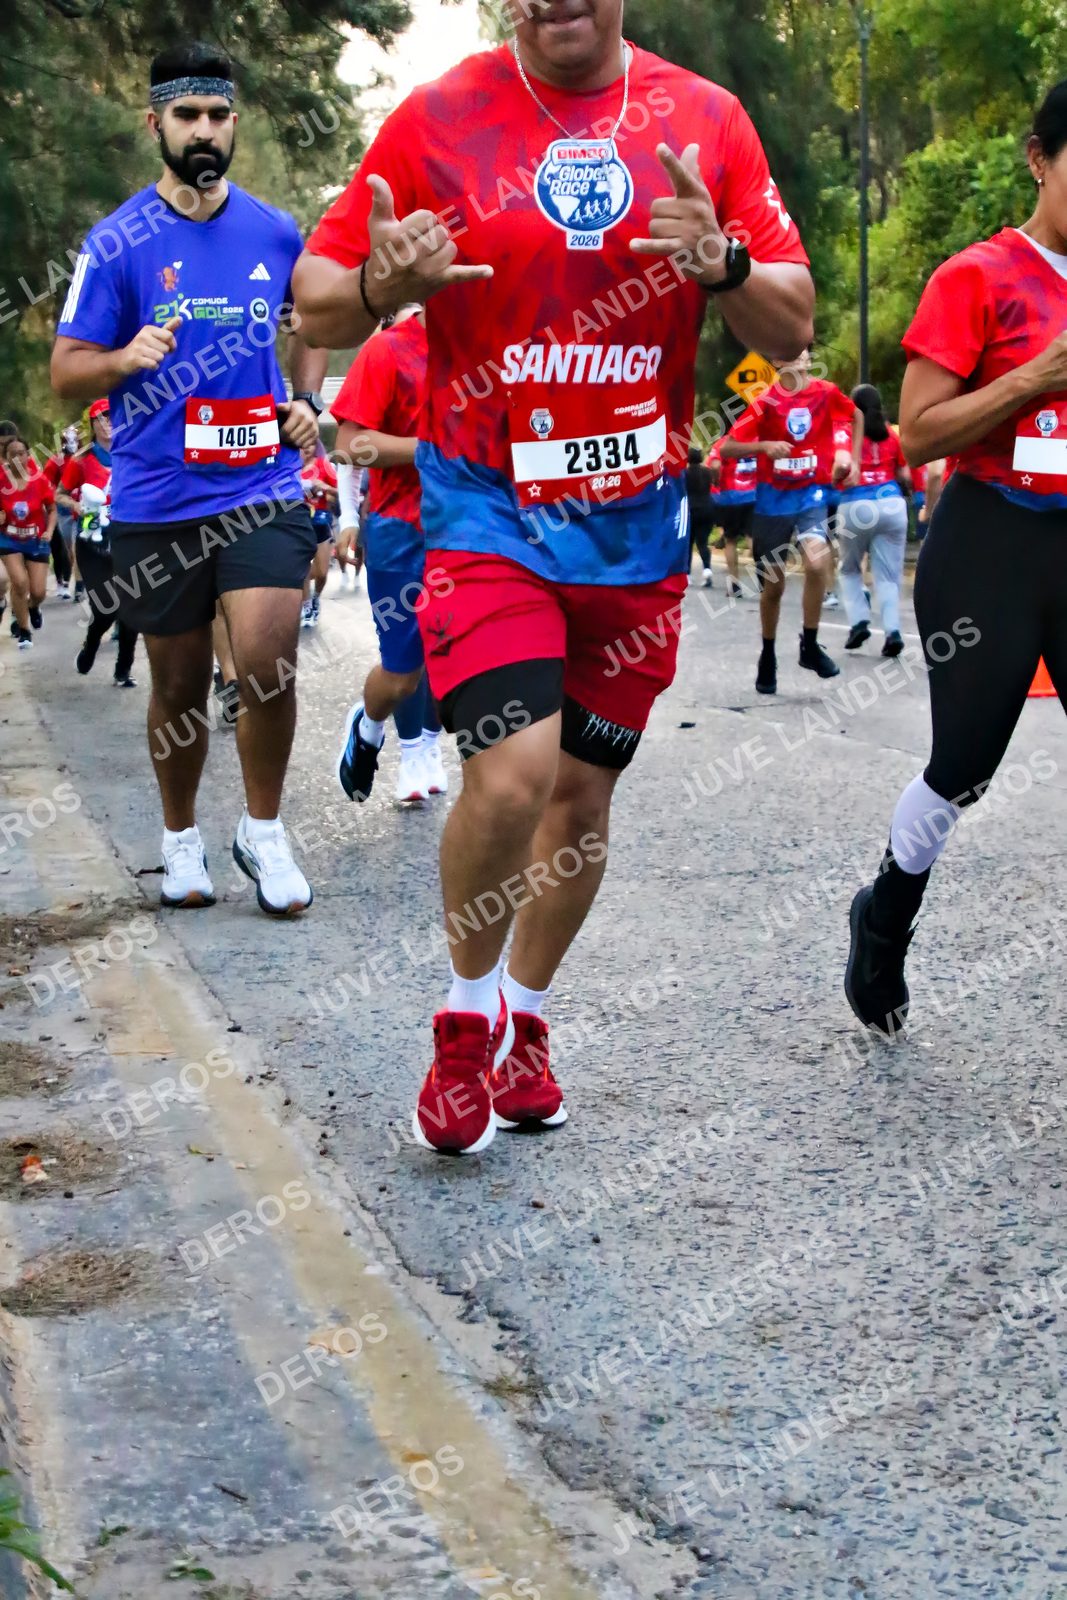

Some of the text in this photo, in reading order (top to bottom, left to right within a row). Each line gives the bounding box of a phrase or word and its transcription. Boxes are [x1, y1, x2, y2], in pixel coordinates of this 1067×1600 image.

[550, 181, 590, 196] Race
[570, 234, 600, 247] 2026
[500, 344, 662, 384] SANTIAGO
[218, 426, 257, 447] 1405
[564, 432, 640, 474] 2334
